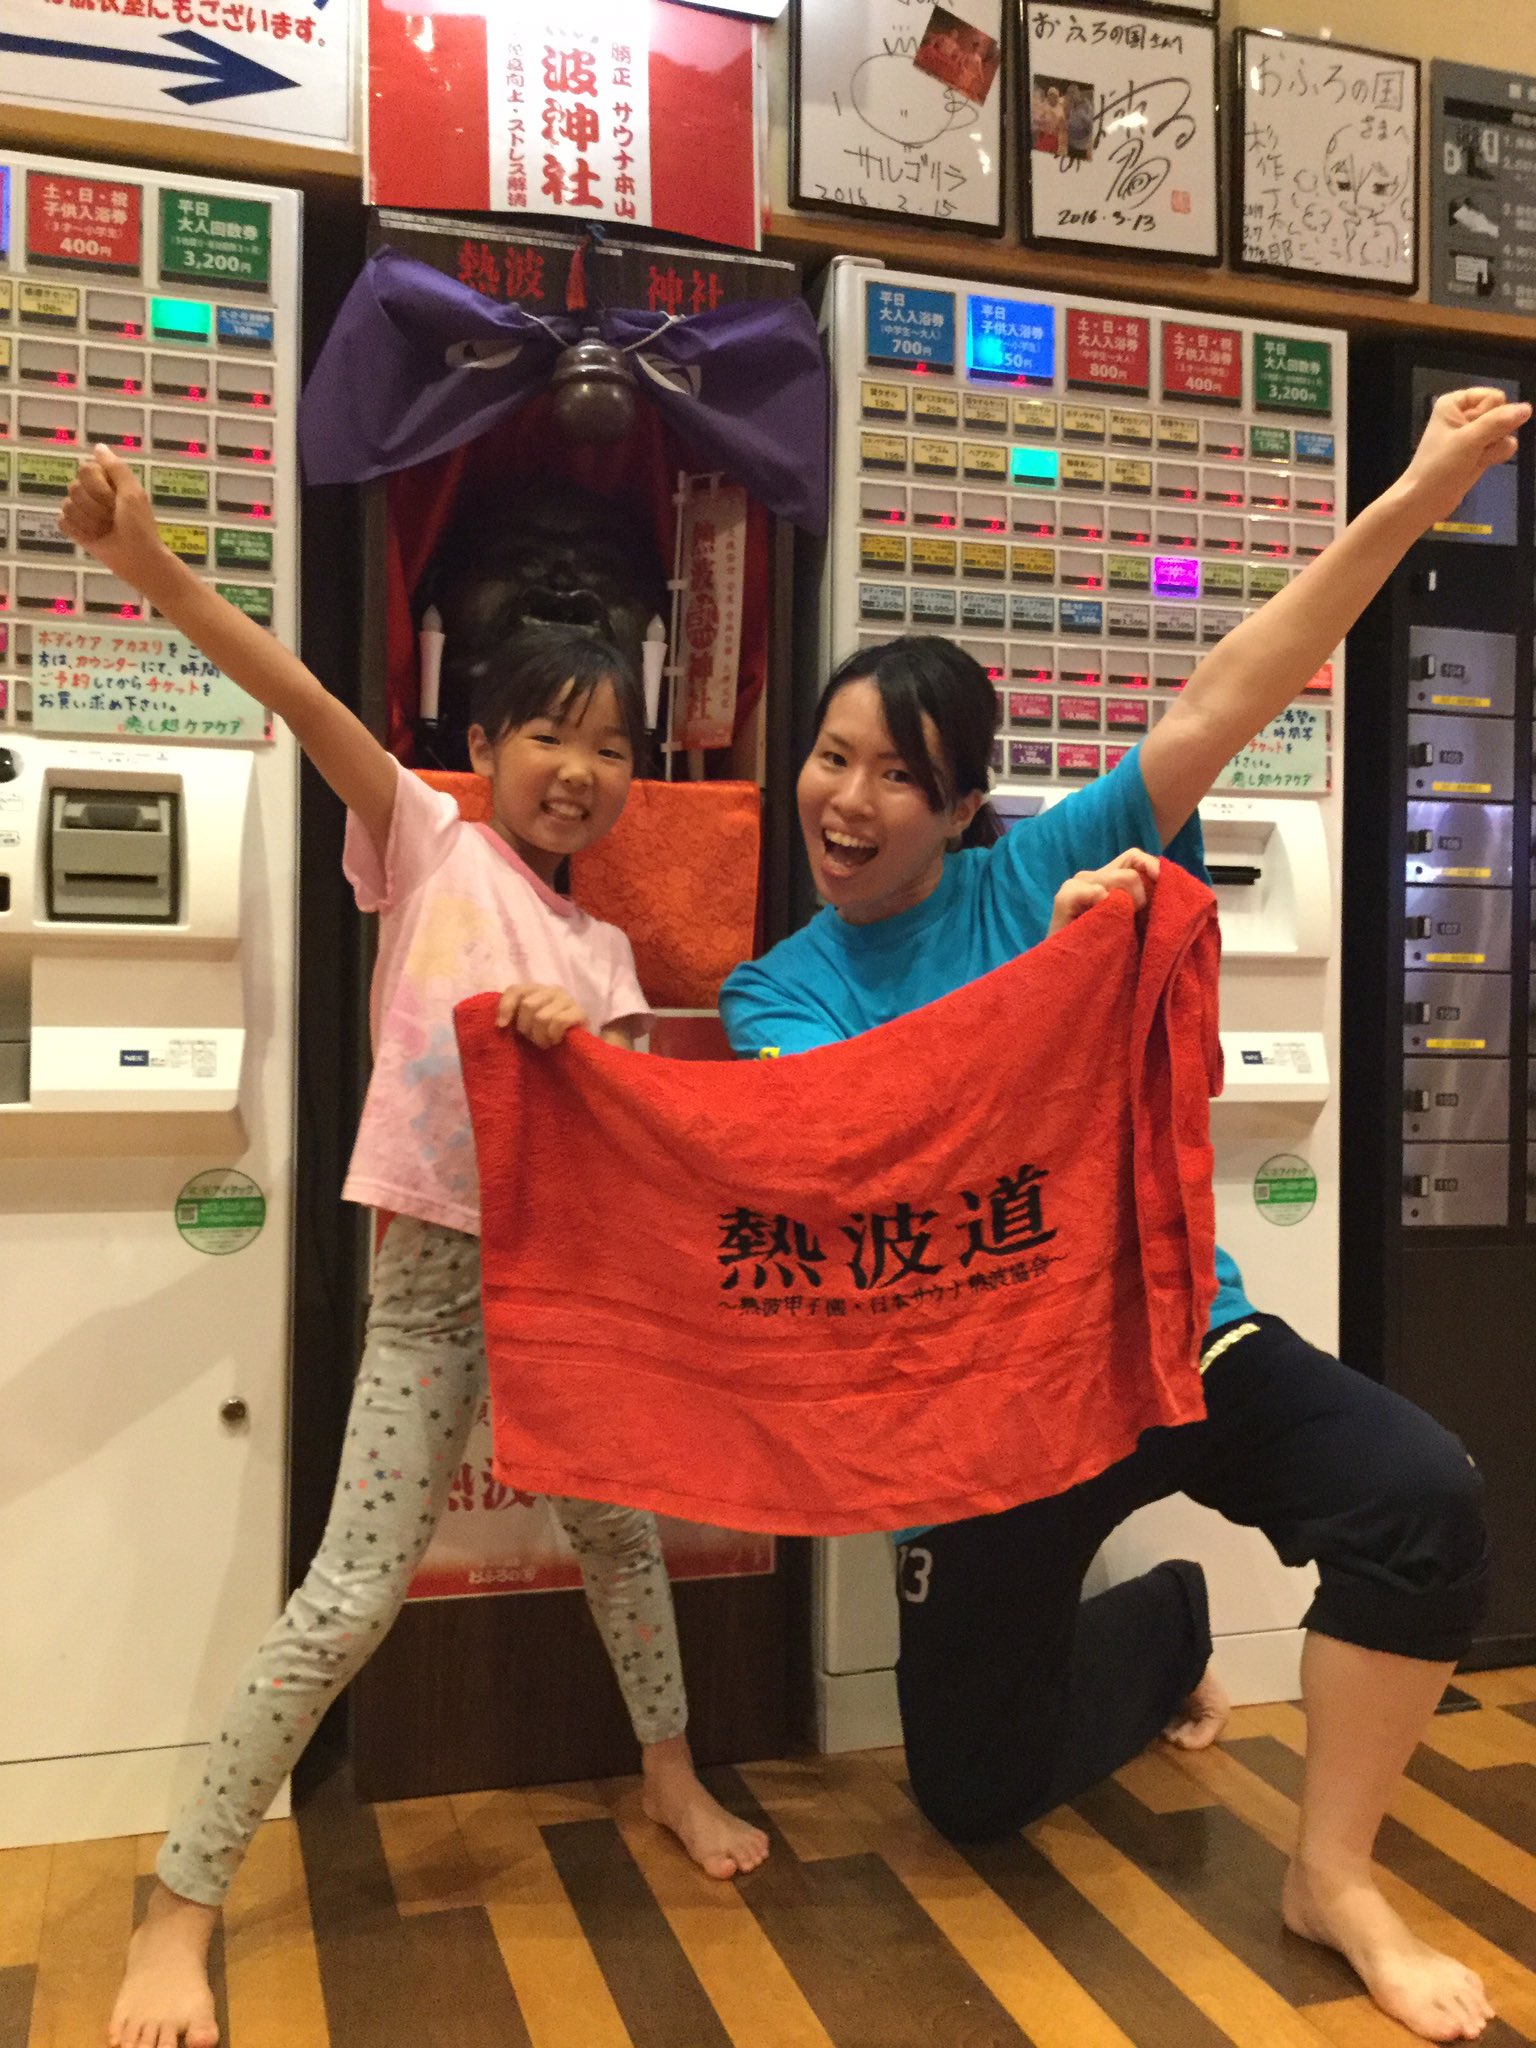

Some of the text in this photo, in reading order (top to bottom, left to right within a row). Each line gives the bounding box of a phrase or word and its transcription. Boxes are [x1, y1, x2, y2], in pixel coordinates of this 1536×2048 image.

[540, 26, 604, 210] 波神社
[612, 102, 637, 220] サウナ本山
[43, 201, 128, 225] 子供入浴券
[177, 199, 210, 217] 平日
[60, 237, 112, 257] 400円
[184, 250, 252, 274] 3,200円
[879, 291, 906, 307] 平日
[879, 308, 945, 328] 大人入浴券
[981, 304, 1007, 321] 平日
[981, 320, 1045, 341] 子供入浴券
[1078, 317, 1139, 337] 土・日・祝
[892, 339, 932, 357] 700円
[1077, 333, 1139, 352] 大人入浴券
[1173, 331, 1233, 351] 土・日・祝
[1264, 341, 1287, 356] 平日
[998, 352, 1033, 369] 50円
[1090, 362, 1127, 380] 800円
[1184, 376, 1222, 393] 400円
[1268, 384, 1317, 402] 3,200円
[717, 1163, 1058, 1291] 熱波道
